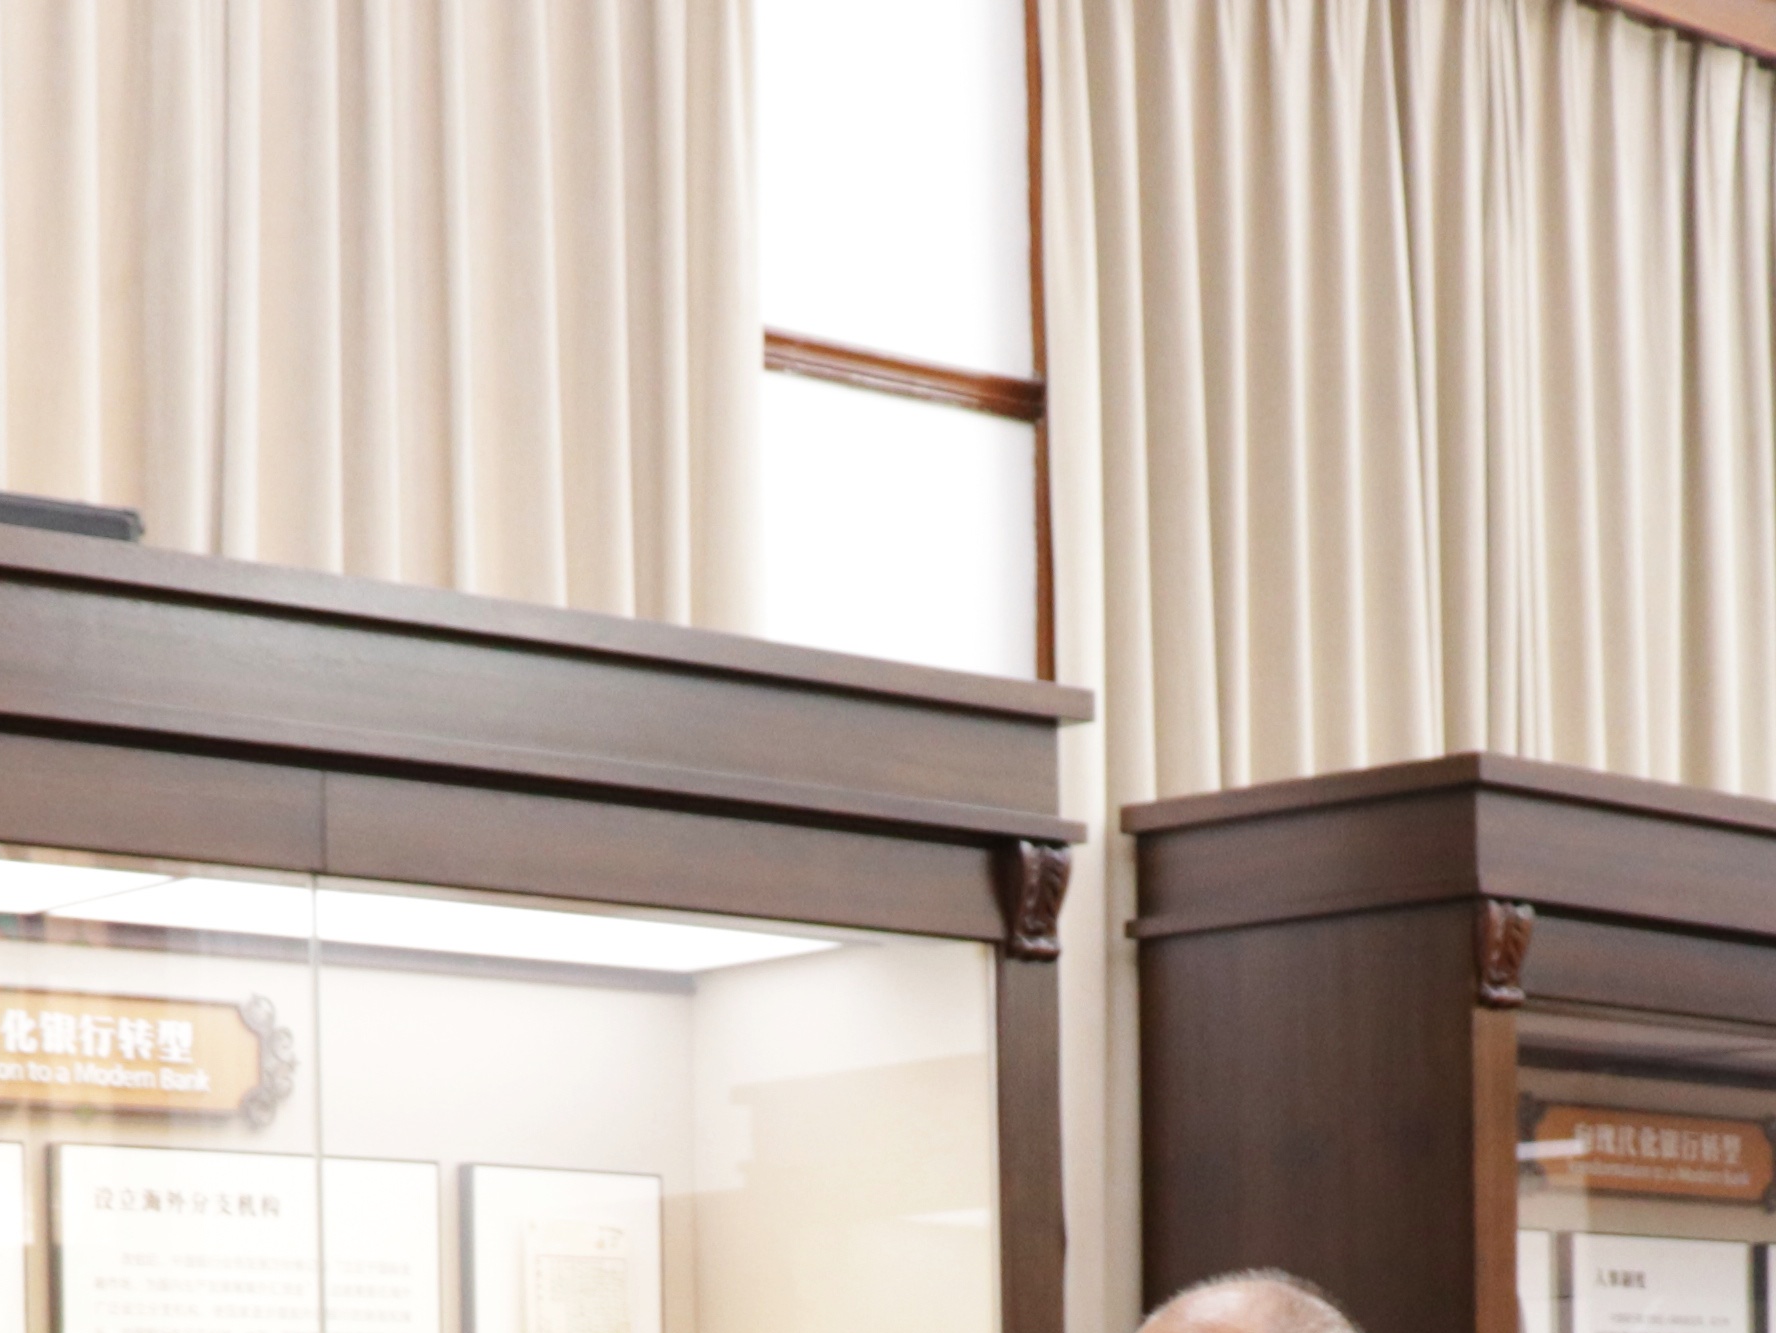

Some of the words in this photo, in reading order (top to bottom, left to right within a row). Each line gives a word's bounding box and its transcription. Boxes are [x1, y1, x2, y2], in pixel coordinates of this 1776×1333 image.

[27, 1061, 53, 1083] to
[54, 1066, 71, 1084] a
[74, 1061, 156, 1089] Modern
[158, 1067, 211, 1093] Bank
